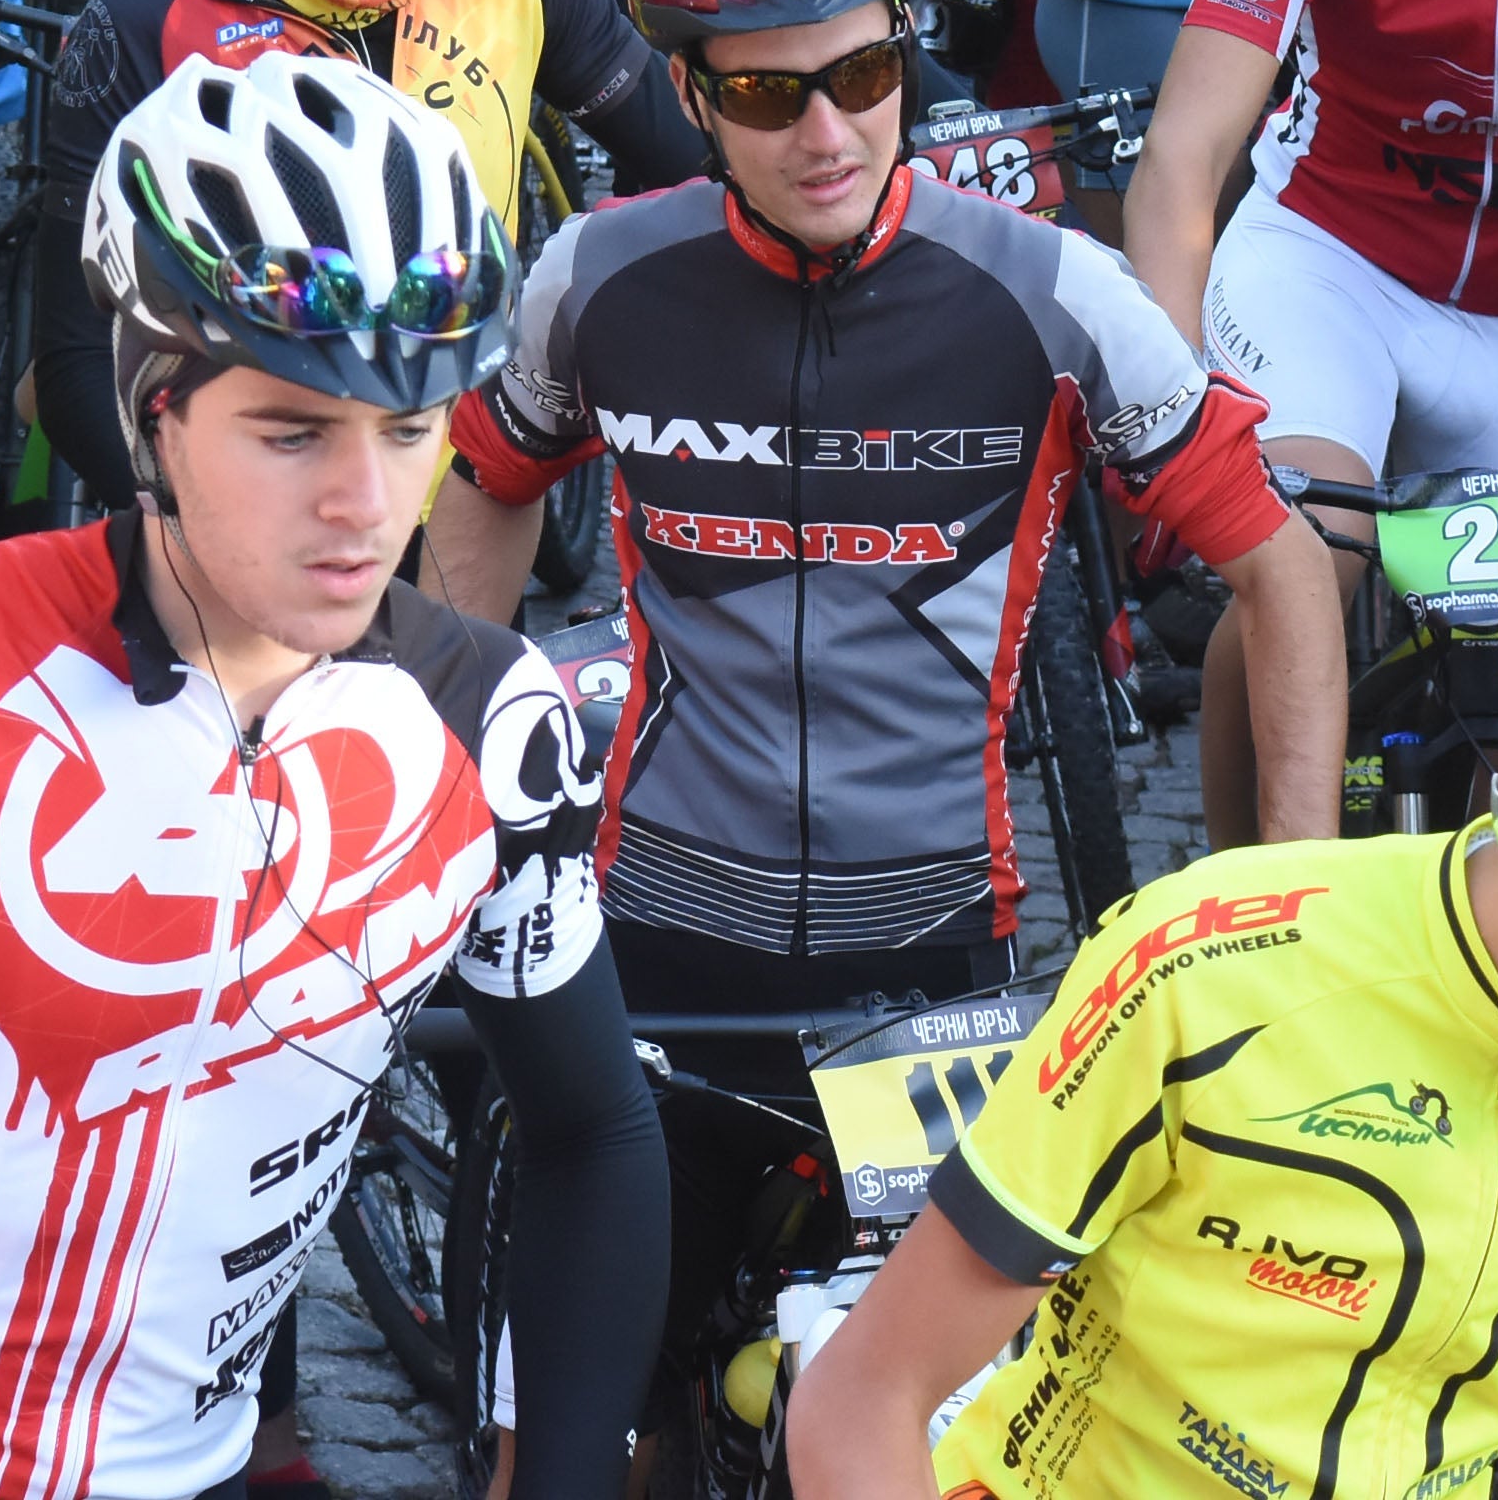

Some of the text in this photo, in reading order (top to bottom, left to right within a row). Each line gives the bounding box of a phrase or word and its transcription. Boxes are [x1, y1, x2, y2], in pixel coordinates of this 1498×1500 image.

[928, 113, 1004, 143] ЧЕРНИ ВРЪХ
[640, 501, 958, 566] KENDA
[911, 1012, 970, 1045] ЧЕРНИ
[971, 1006, 1023, 1038] ВРЪХ
[1050, 927, 1303, 1111] PASSION ON TWO WHEELS
[905, 1049, 1014, 1156] 11
[887, 1165, 931, 1195] soph
[1196, 1214, 1368, 1281] R.IVO
[1248, 1256, 1377, 1314] motori
[1176, 1401, 1290, 1499] ТАНДЕМ
